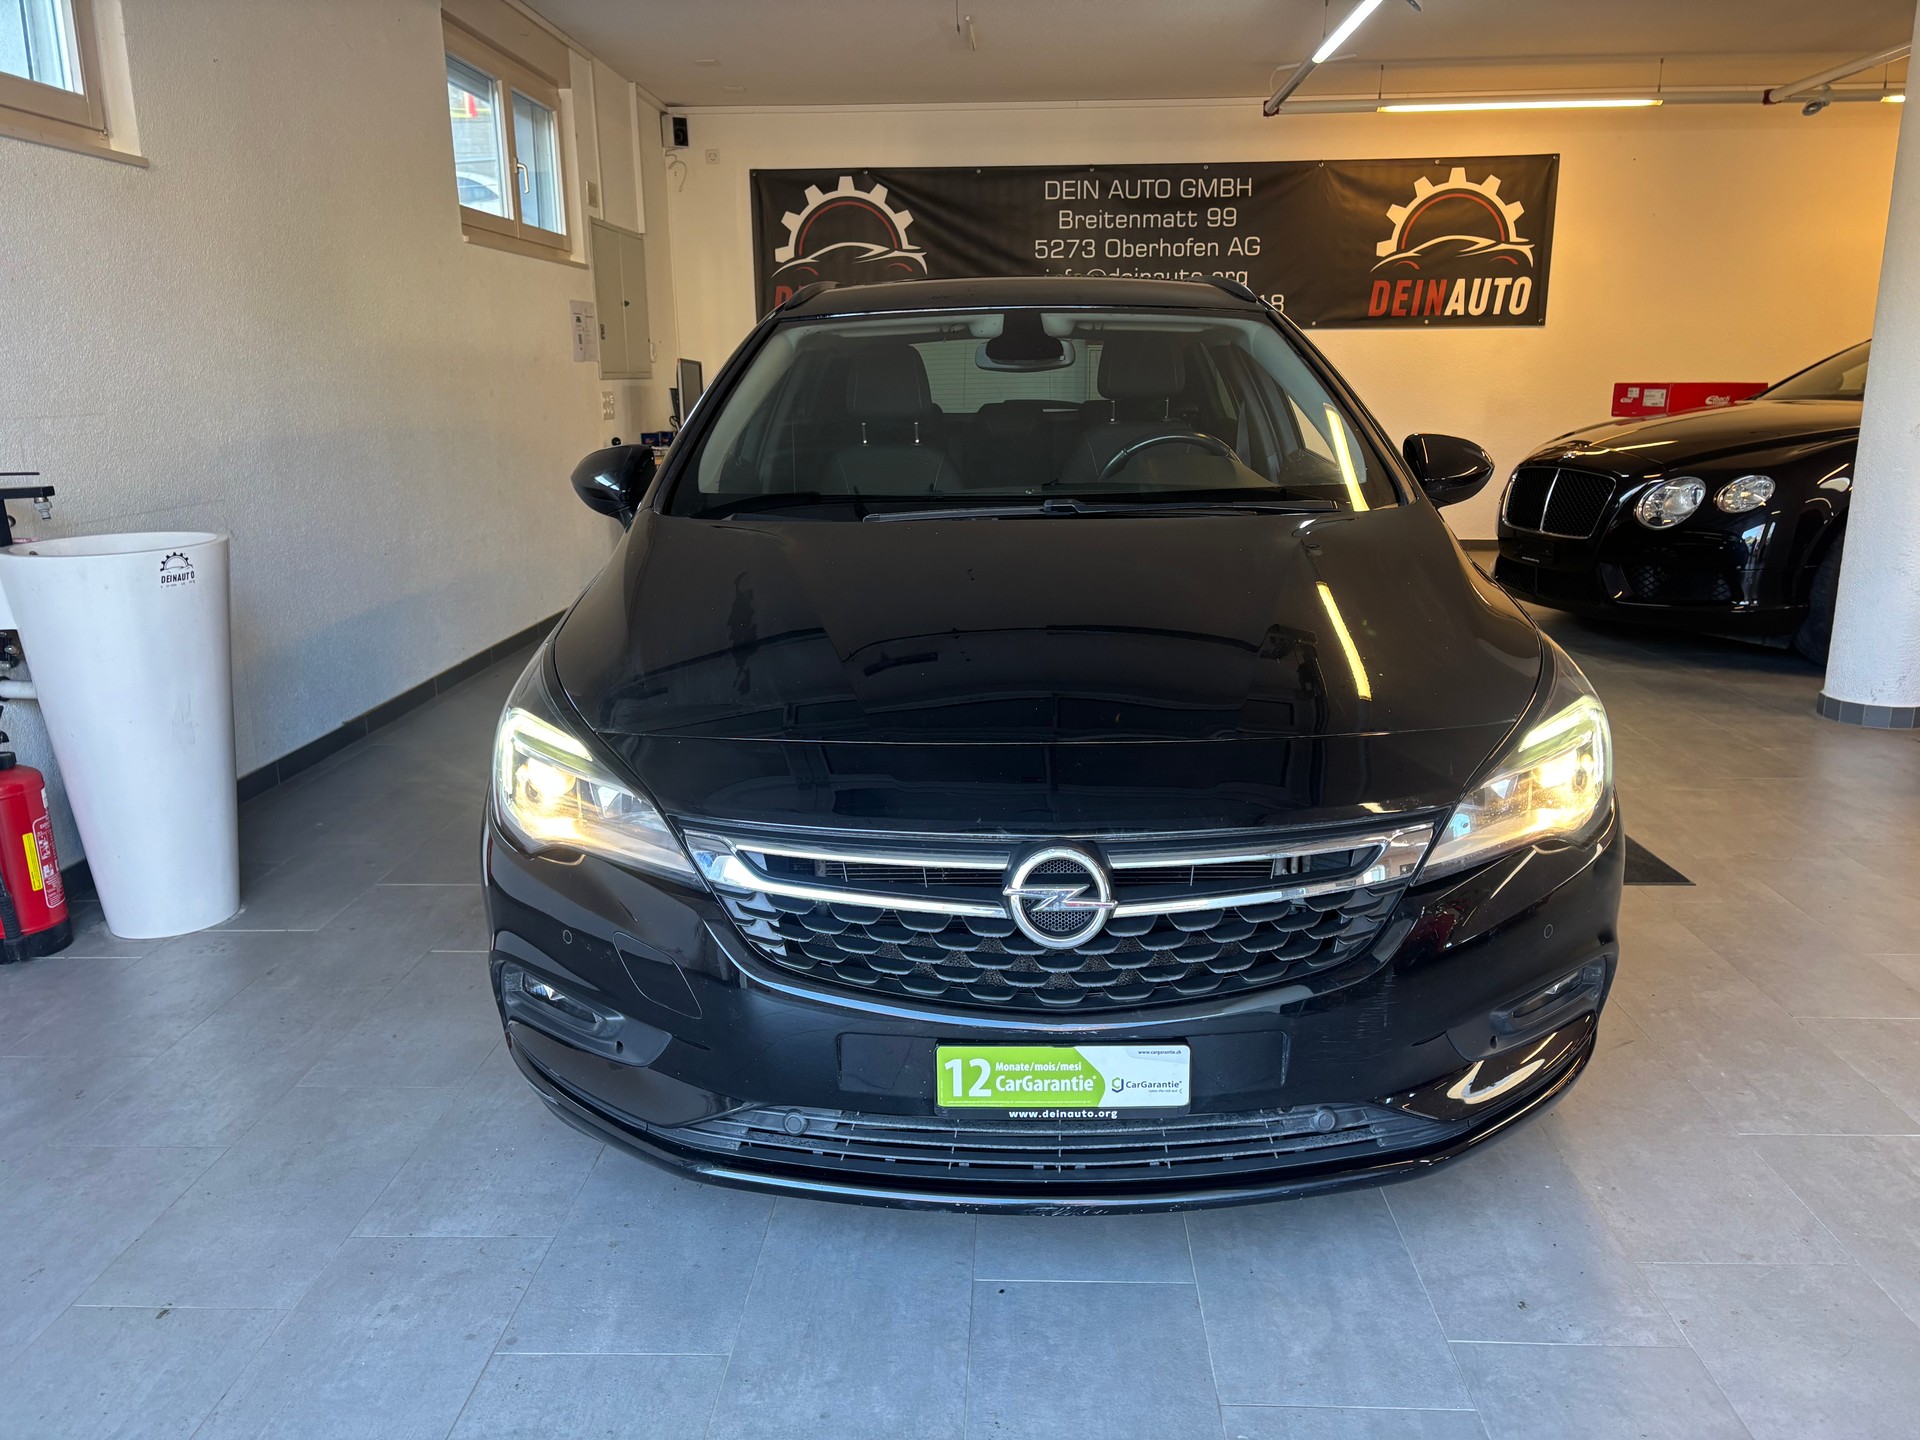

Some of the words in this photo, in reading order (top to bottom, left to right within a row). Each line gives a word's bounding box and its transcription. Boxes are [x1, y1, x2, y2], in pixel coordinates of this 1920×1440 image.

[1044, 179, 1099, 200] DEIN
[1107, 178, 1171, 199] AUTO
[1180, 177, 1252, 198] GMBH
[1058, 209, 1198, 229] Breitenmatt
[1207, 207, 1237, 227] 99
[1034, 239, 1096, 259] 5273
[1105, 238, 1219, 258] Oberhofen
[1227, 236, 1261, 256] AG
[1367, 276, 1533, 317] DEINAUTO
[161, 570, 195, 584] DEINAUTO
[944, 1058, 992, 1097] 12
[1008, 1109, 1118, 1120] www.deinauto.org
